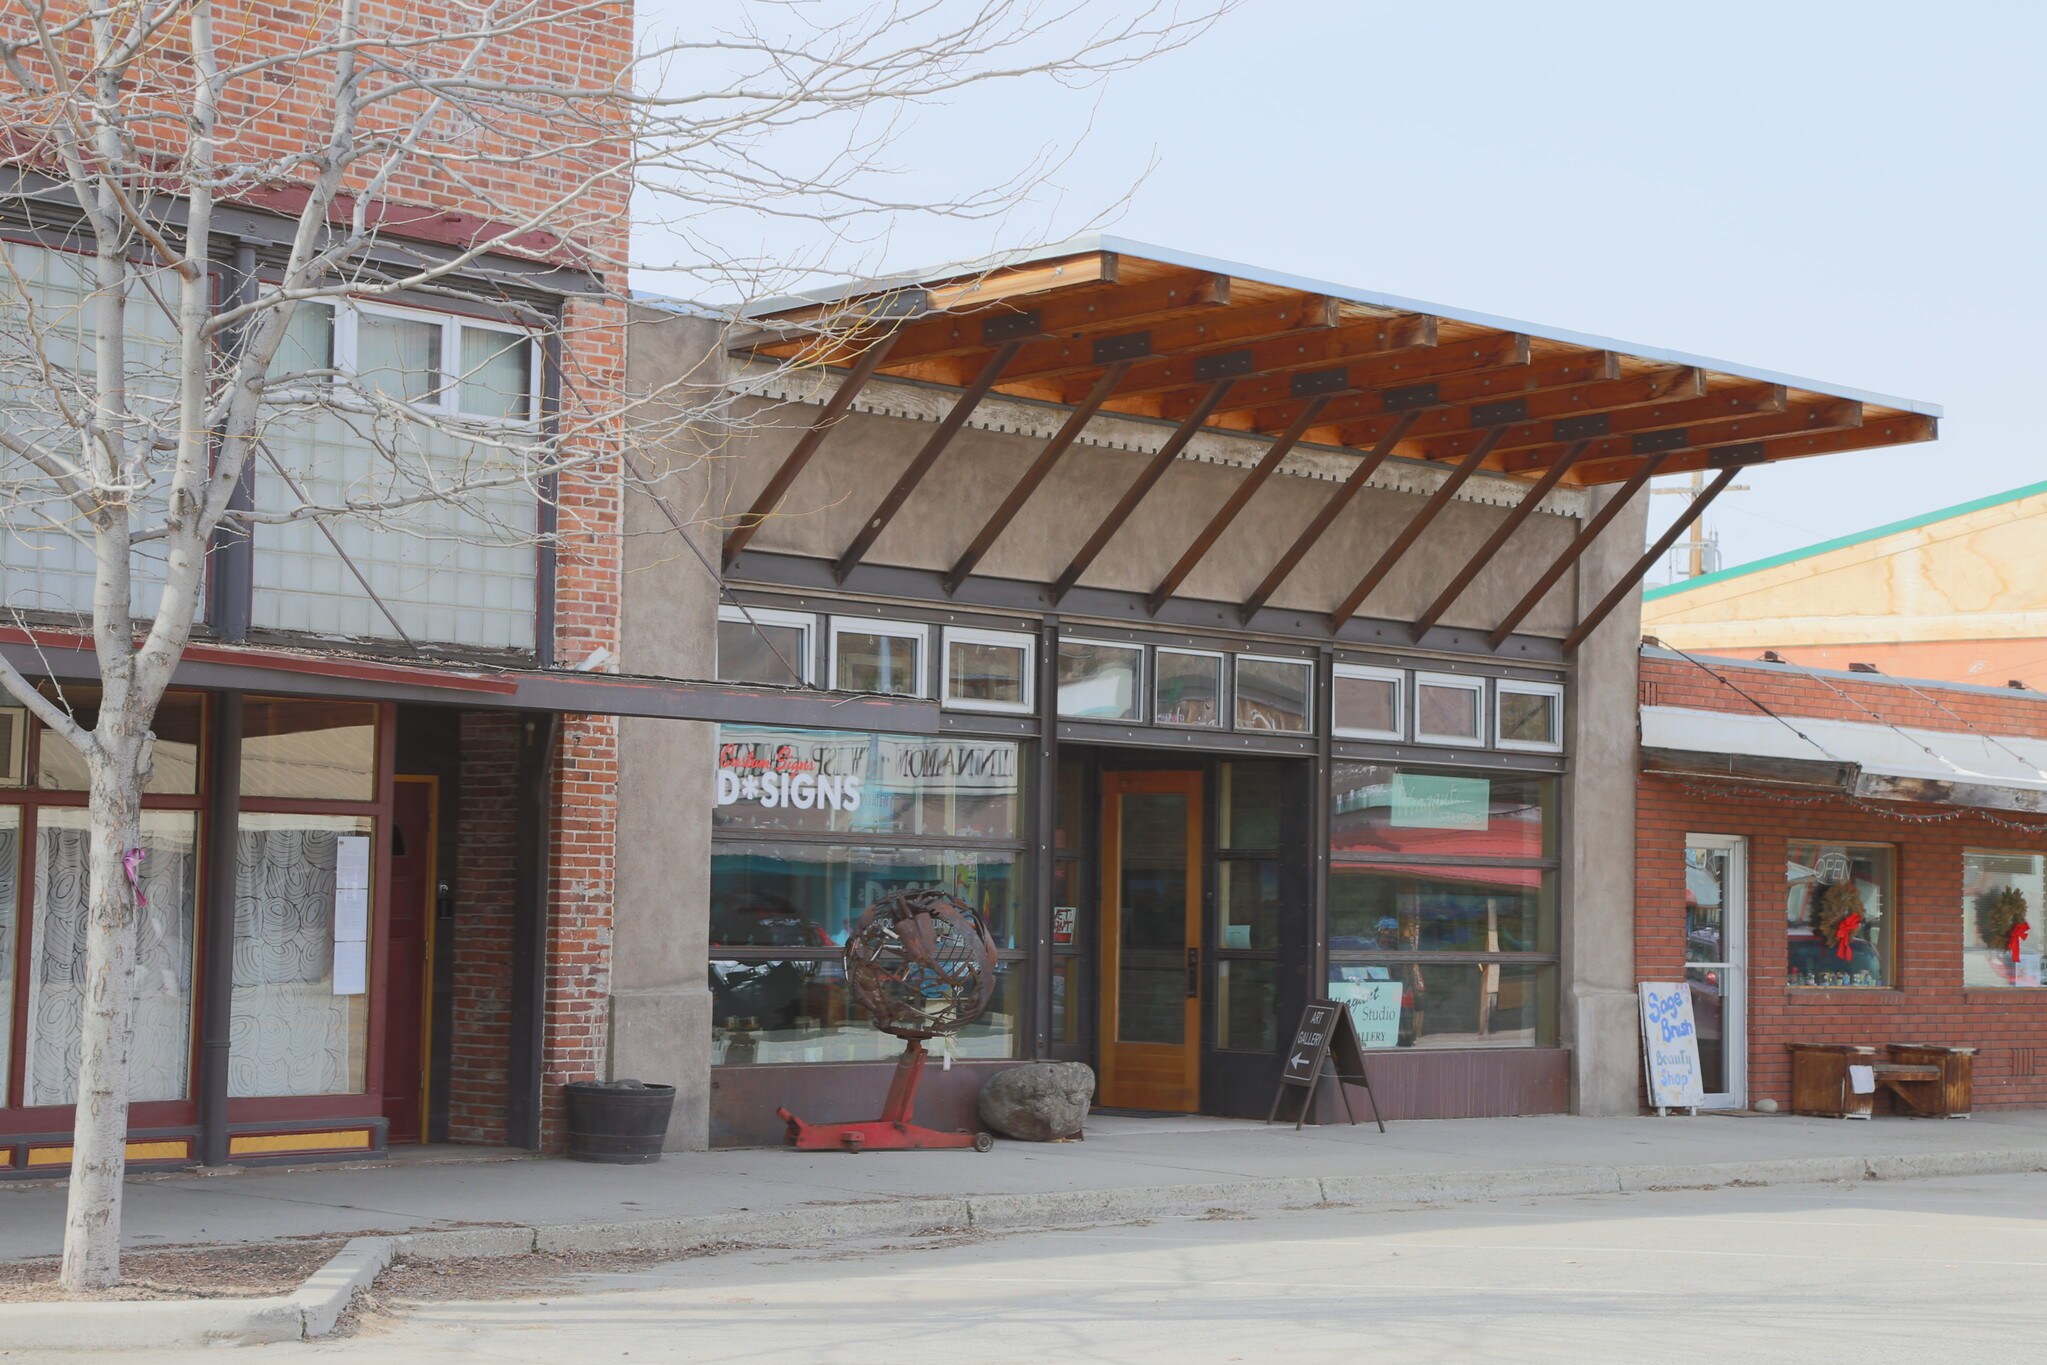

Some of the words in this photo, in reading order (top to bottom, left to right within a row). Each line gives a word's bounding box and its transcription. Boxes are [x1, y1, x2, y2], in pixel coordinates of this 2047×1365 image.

[720, 743, 771, 769] Custom
[775, 746, 816, 779] Signs
[1814, 858, 1853, 880] OPEN
[1310, 1011, 1325, 1024] ART
[1362, 1006, 1396, 1021] Studio
[1648, 992, 1683, 1023] Sage
[1297, 1031, 1324, 1046] GALLERY
[1358, 1032, 1387, 1041] ALLERY
[1661, 1018, 1693, 1043] Brush
[1656, 1050, 1693, 1075] Beauty
[1661, 1068, 1688, 1091] Shop
